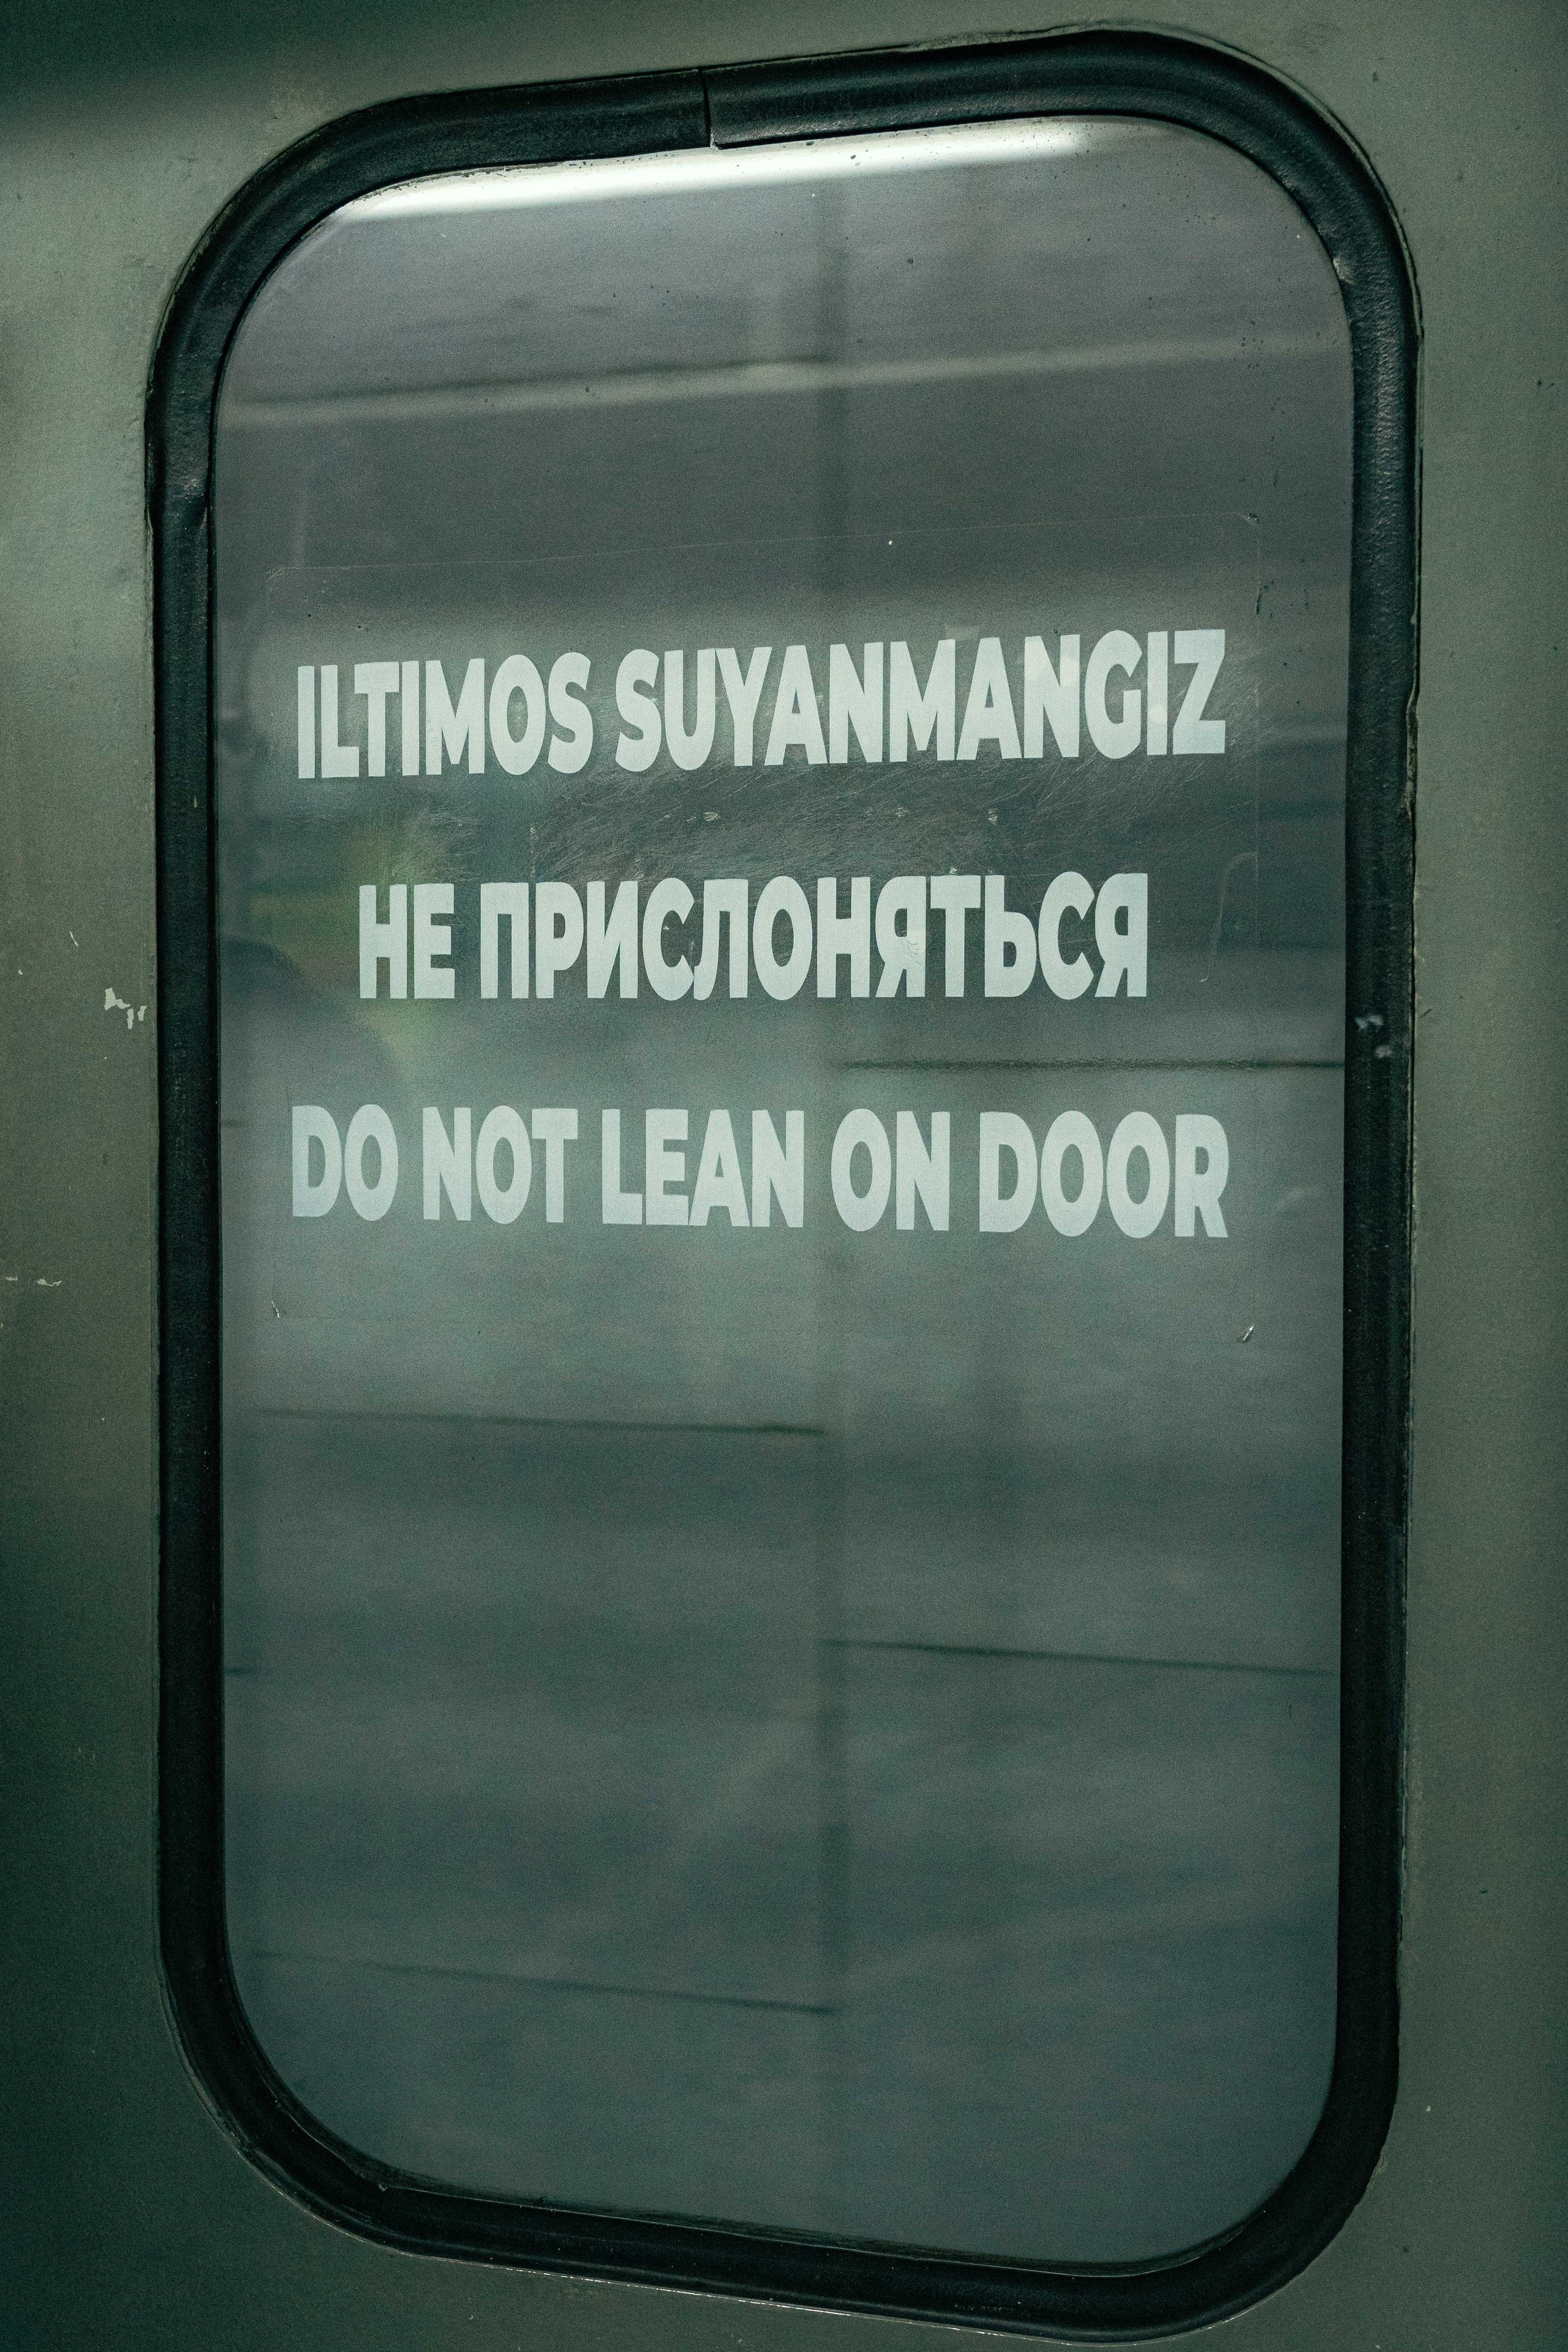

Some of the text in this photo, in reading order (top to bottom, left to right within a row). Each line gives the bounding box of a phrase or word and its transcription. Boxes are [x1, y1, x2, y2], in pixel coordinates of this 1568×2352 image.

[297, 629, 1226, 779] ILTIMOS SUYANMANGIZ
[359, 872, 1148, 1001] НЕ ПРИСЛОНЯТЬСЯ
[292, 1104, 1229, 1238] DO NOT LEAN ON DOOR
